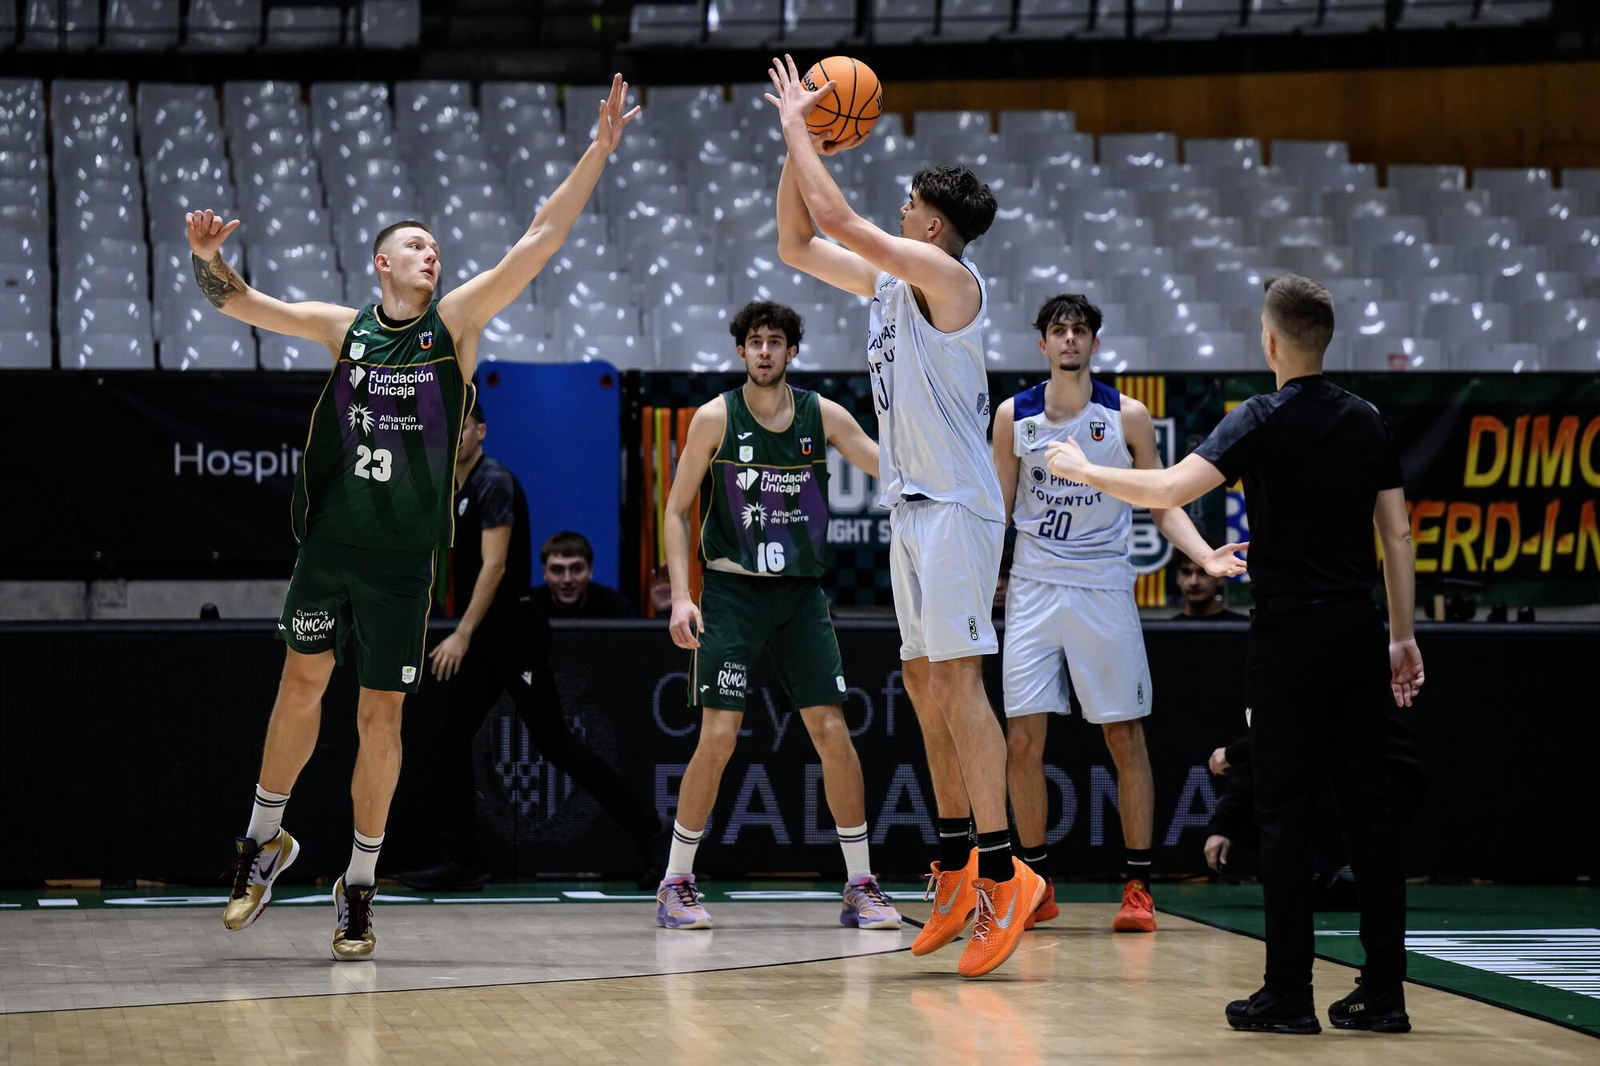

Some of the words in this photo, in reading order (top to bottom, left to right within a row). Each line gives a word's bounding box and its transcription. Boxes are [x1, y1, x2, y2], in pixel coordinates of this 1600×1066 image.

[369, 370, 434, 384] Fundación
[368, 382, 415, 399] Unicaja
[379, 414, 416, 423] Alhaurín
[379, 423, 389, 431] de
[391, 423, 399, 431] la
[400, 423, 424, 431] Torre
[354, 444, 393, 482] 23
[762, 471, 811, 484] Fundació
[760, 481, 801, 497] Unicaja
[1030, 485, 1103, 507] JOVENTUT
[1038, 510, 1073, 541] 20
[757, 542, 786, 572] 16
[296, 633, 327, 642] DENTAL
